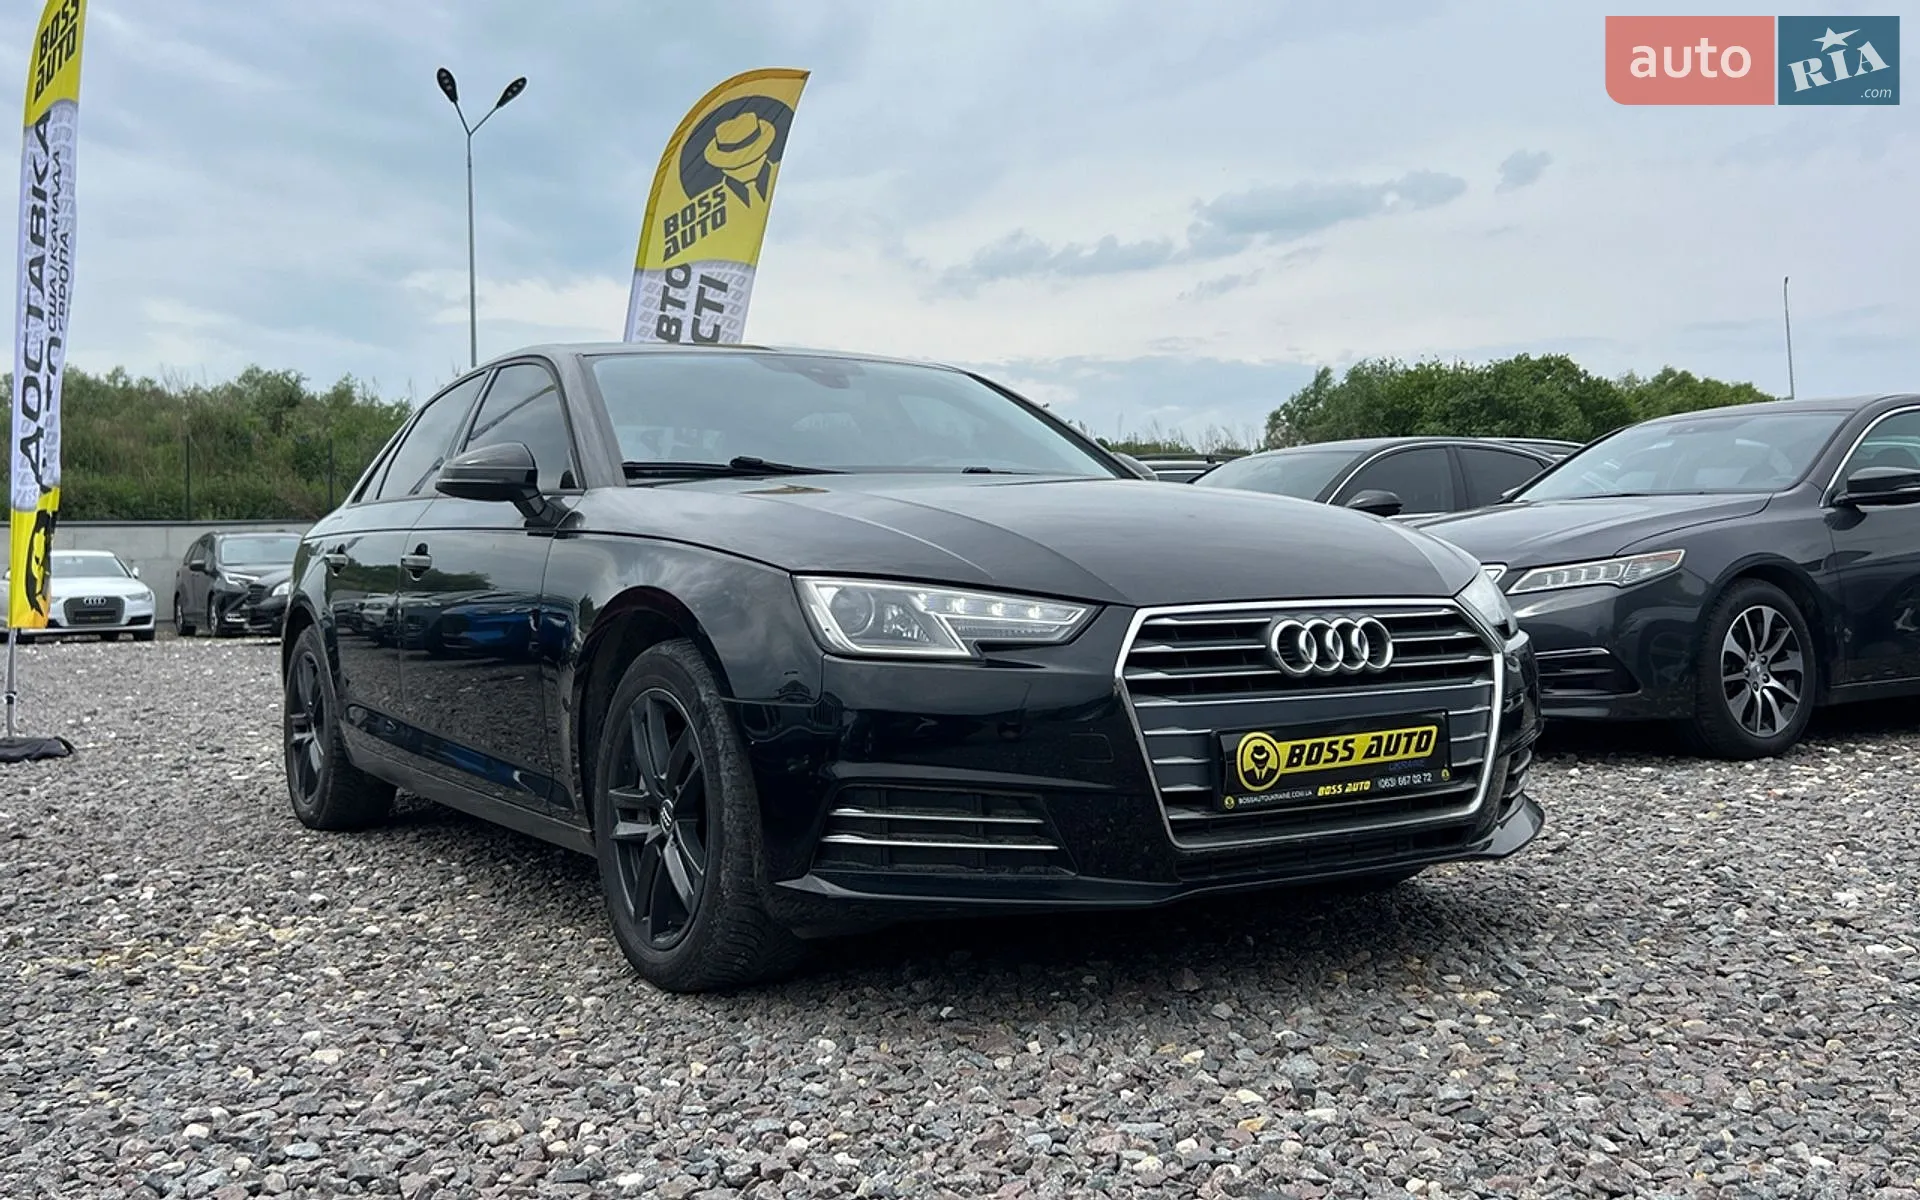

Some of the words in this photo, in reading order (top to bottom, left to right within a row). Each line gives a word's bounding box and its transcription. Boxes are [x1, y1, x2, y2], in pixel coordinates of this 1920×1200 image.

[39, 0, 79, 65] BOSS
[34, 22, 77, 104] AUTO
[663, 206, 727, 262] AUTO
[664, 185, 727, 239] BOSS
[20, 109, 51, 494] ДОСТАВКА
[1285, 737, 1357, 769] BOSS
[1362, 730, 1434, 760] AUTO
[1317, 784, 1343, 797] BOSS
[1344, 780, 1371, 794] AUTO
[1422, 772, 1433, 783] 72
